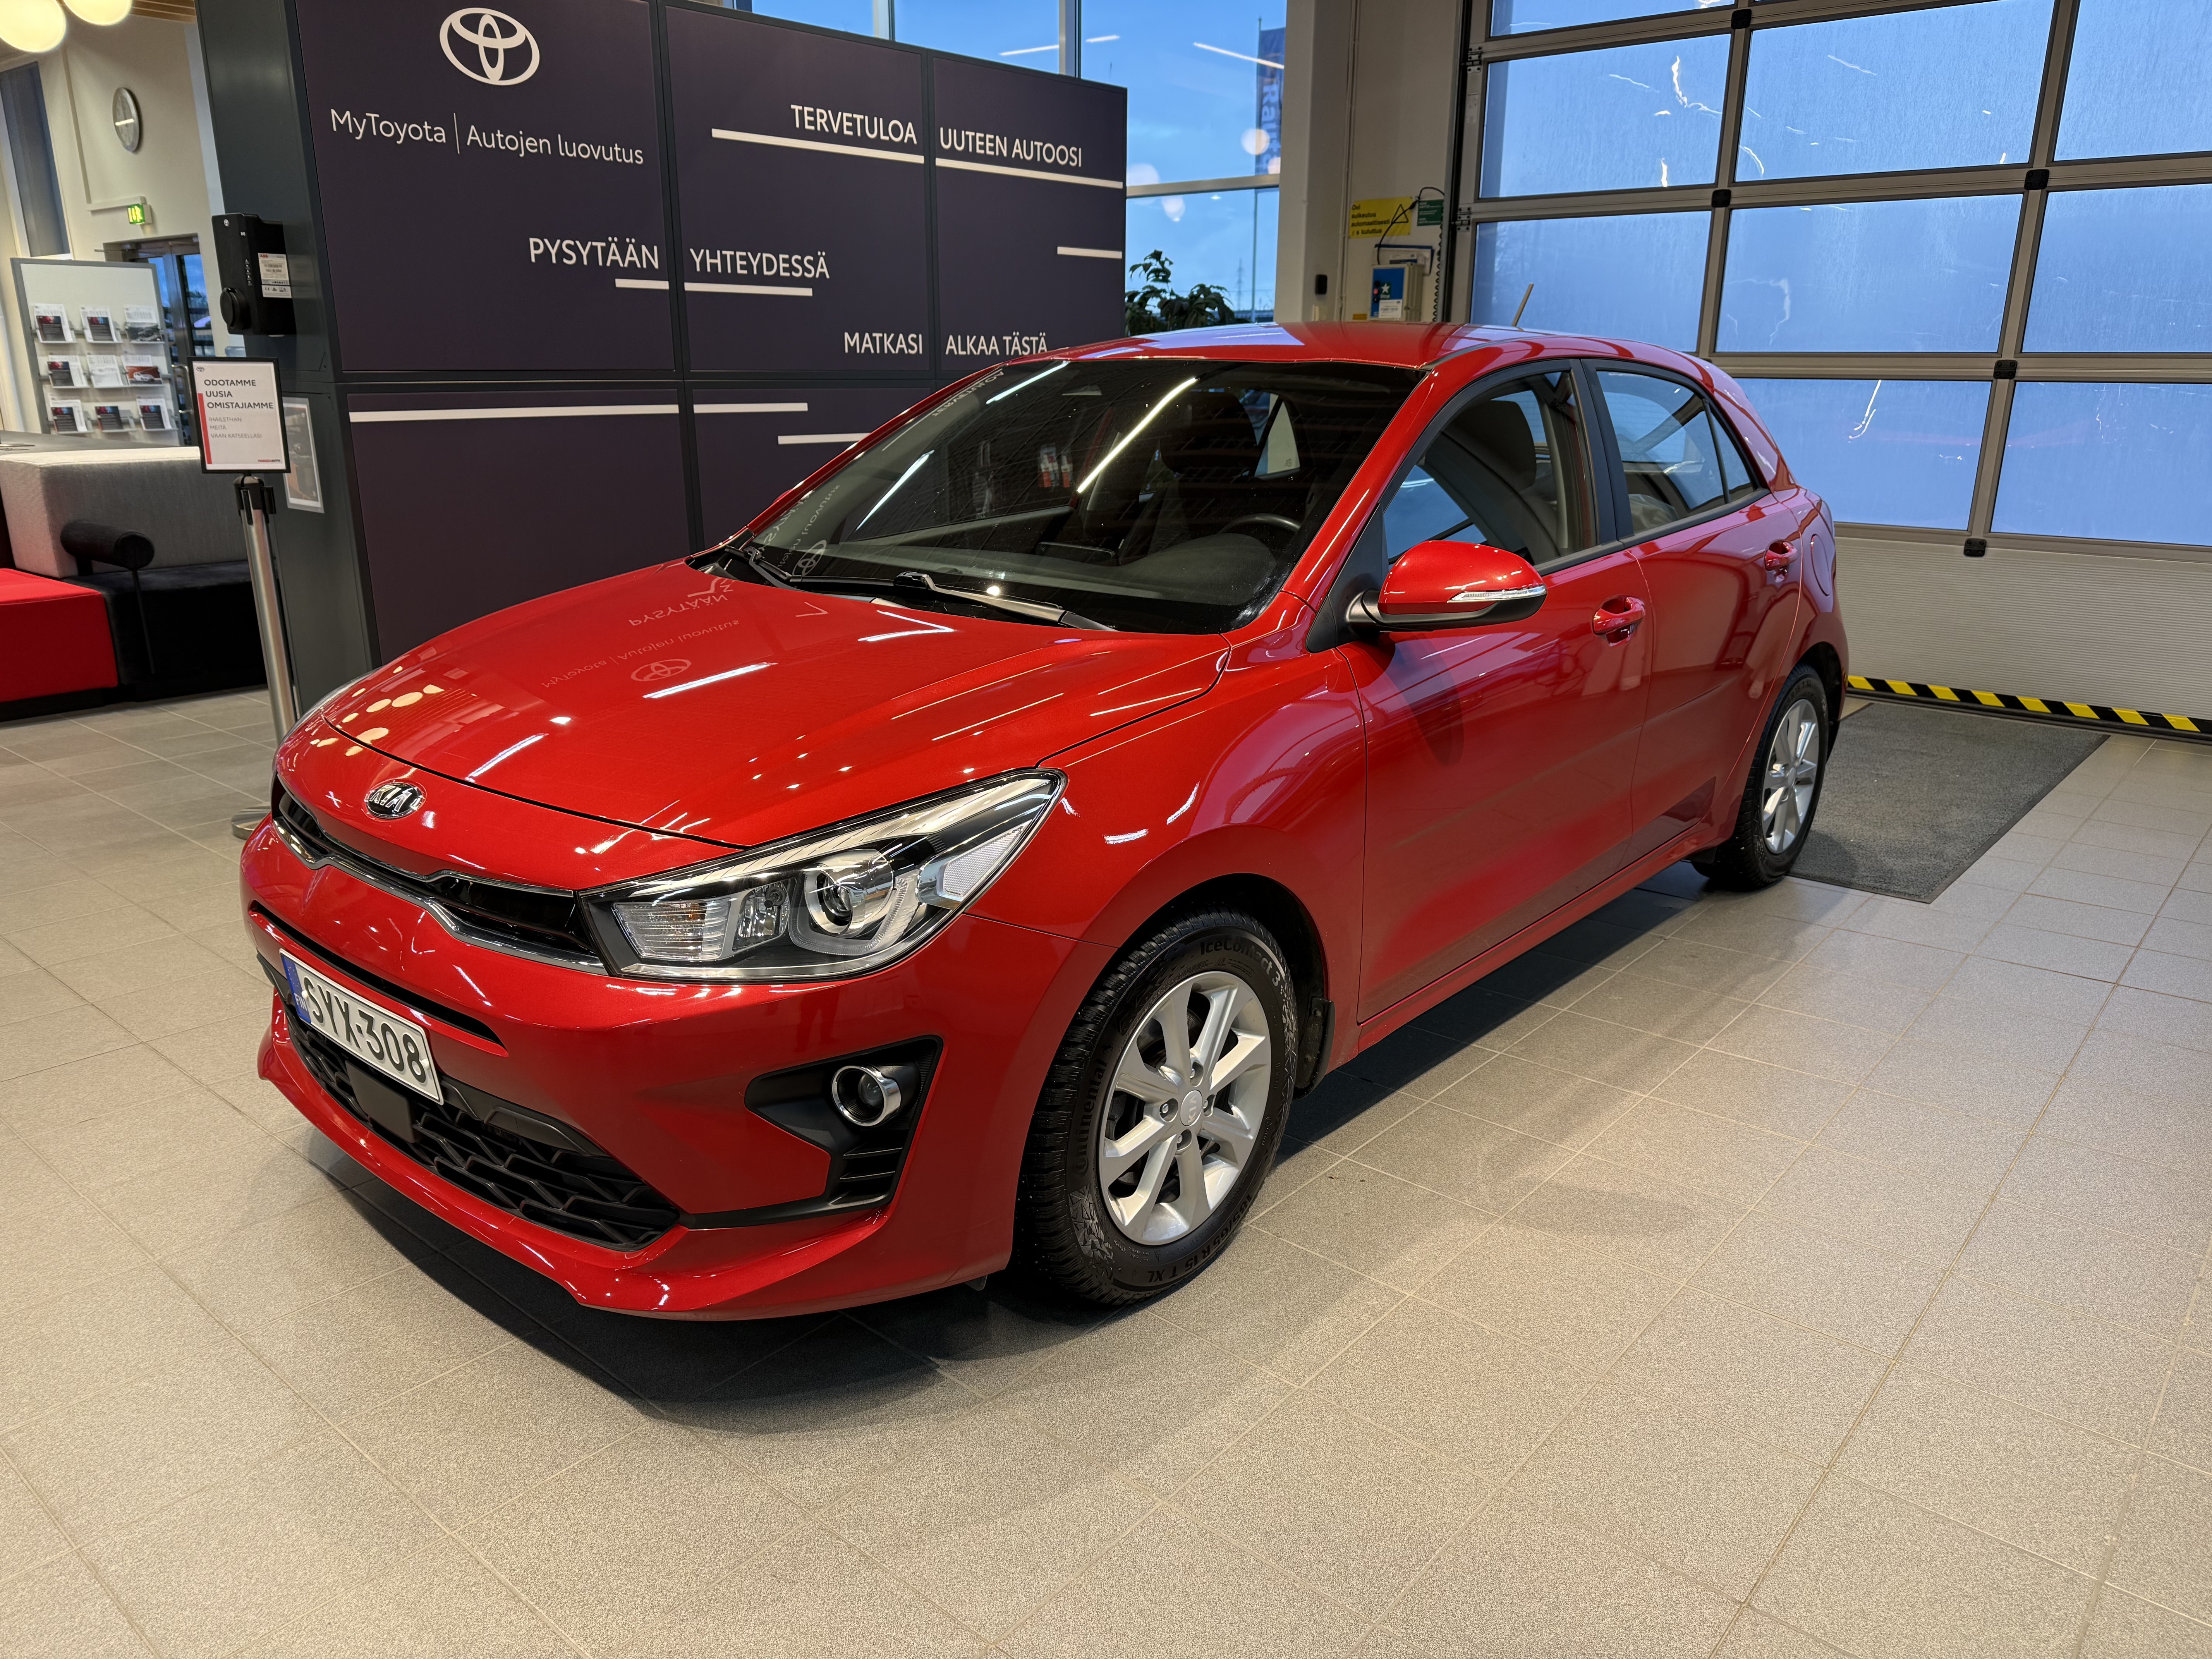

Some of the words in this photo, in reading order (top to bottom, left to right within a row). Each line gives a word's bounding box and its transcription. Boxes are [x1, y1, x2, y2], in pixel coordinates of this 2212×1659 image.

[331, 109, 446, 144] MyToyota
[467, 125, 551, 157] Autojen
[558, 134, 643, 164] luovutus
[790, 104, 917, 145] TERVETULOA
[940, 127, 1007, 157] UUTEEN
[1012, 139, 1082, 167] AUTOOSI
[529, 237, 659, 269] PYSYTÄÄN
[690, 249, 830, 278] YHTEYDESSÄ
[844, 332, 922, 354] MATKASI
[945, 335, 1000, 355] ALKAA
[1003, 331, 1048, 356] TÄSTÄ
[369, 785, 413, 812] KIA
[1201, 939, 1273, 975] IceContact
[1272, 971, 1281, 986] 3
[294, 993, 308, 1011] FIN
[304, 977, 426, 1083] SYX-308
[1073, 1058, 1108, 1177] Continental
[1187, 1093, 1197, 1124] KIA
[1213, 1194, 1253, 1250] 185/65
[1185, 1255, 1199, 1272] 15
[1201, 1245, 1211, 1257] R
[1147, 1270, 1166, 1283] XL
[1168, 1266, 1178, 1279] T
